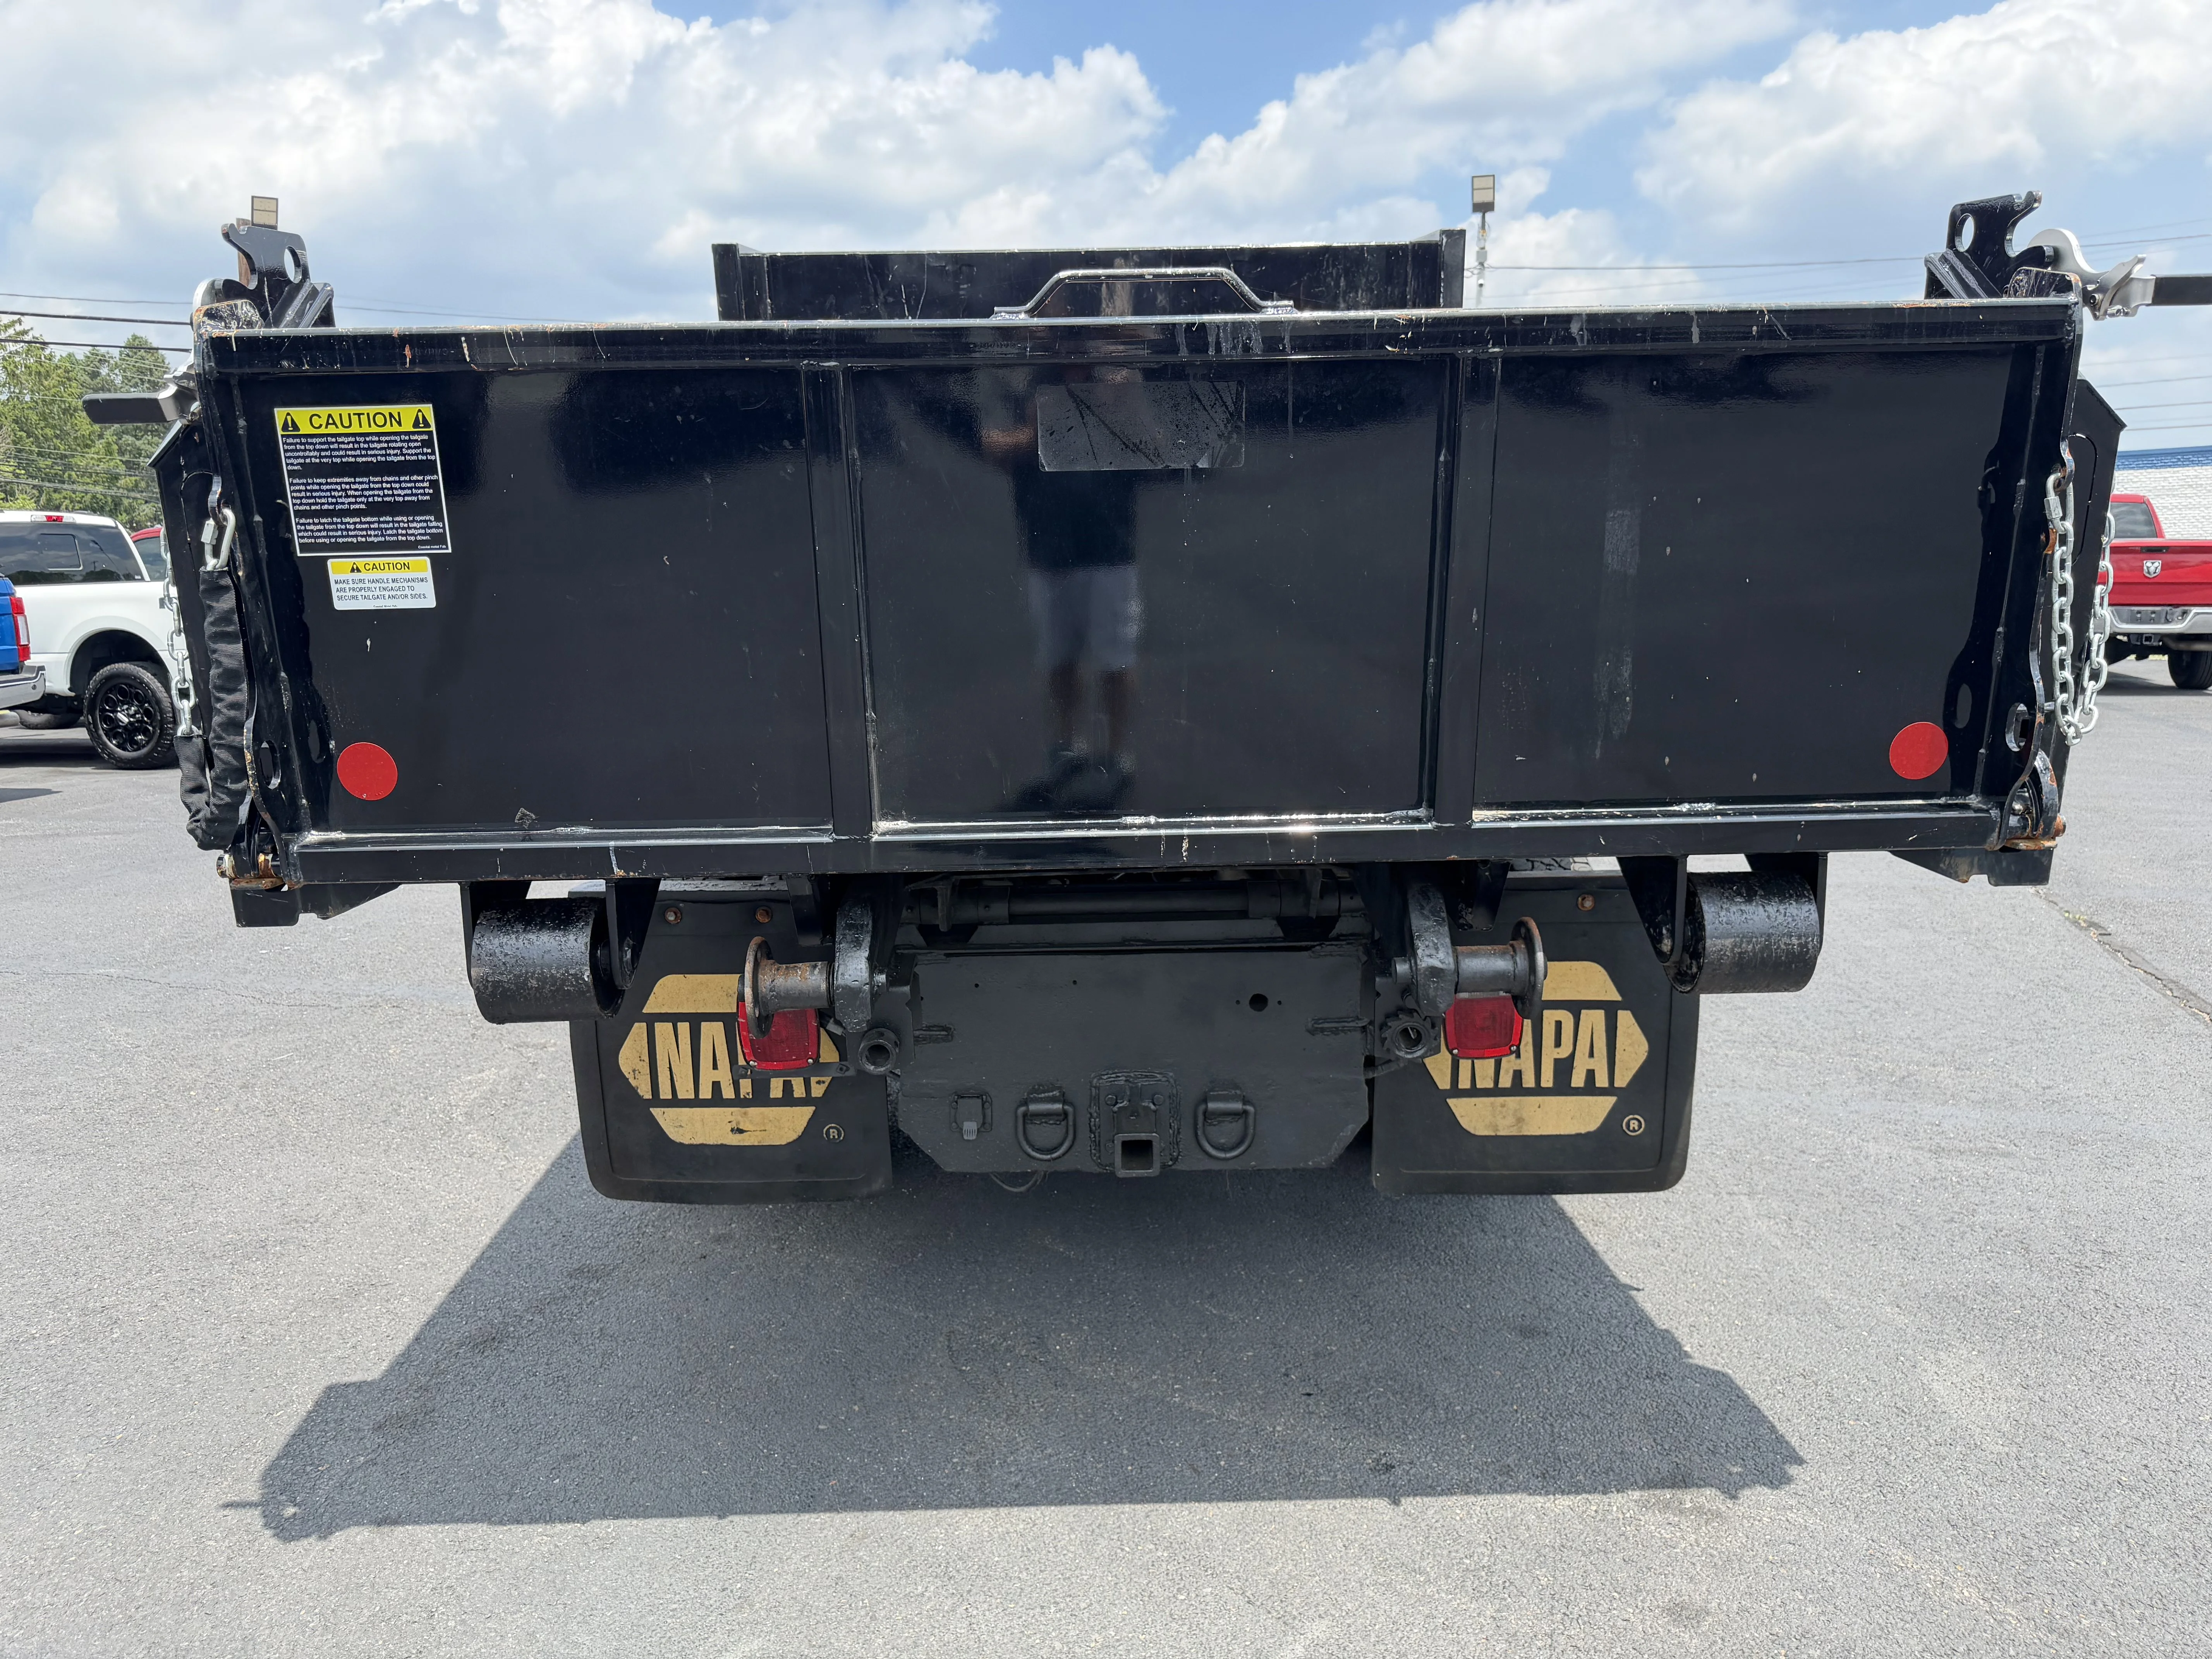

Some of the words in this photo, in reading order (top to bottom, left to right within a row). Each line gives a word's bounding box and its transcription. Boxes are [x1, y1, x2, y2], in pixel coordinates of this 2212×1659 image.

[309, 411, 402, 429] CAUTION
[364, 562, 410, 571] CAUTION
[654, 1022, 806, 1099] NA
